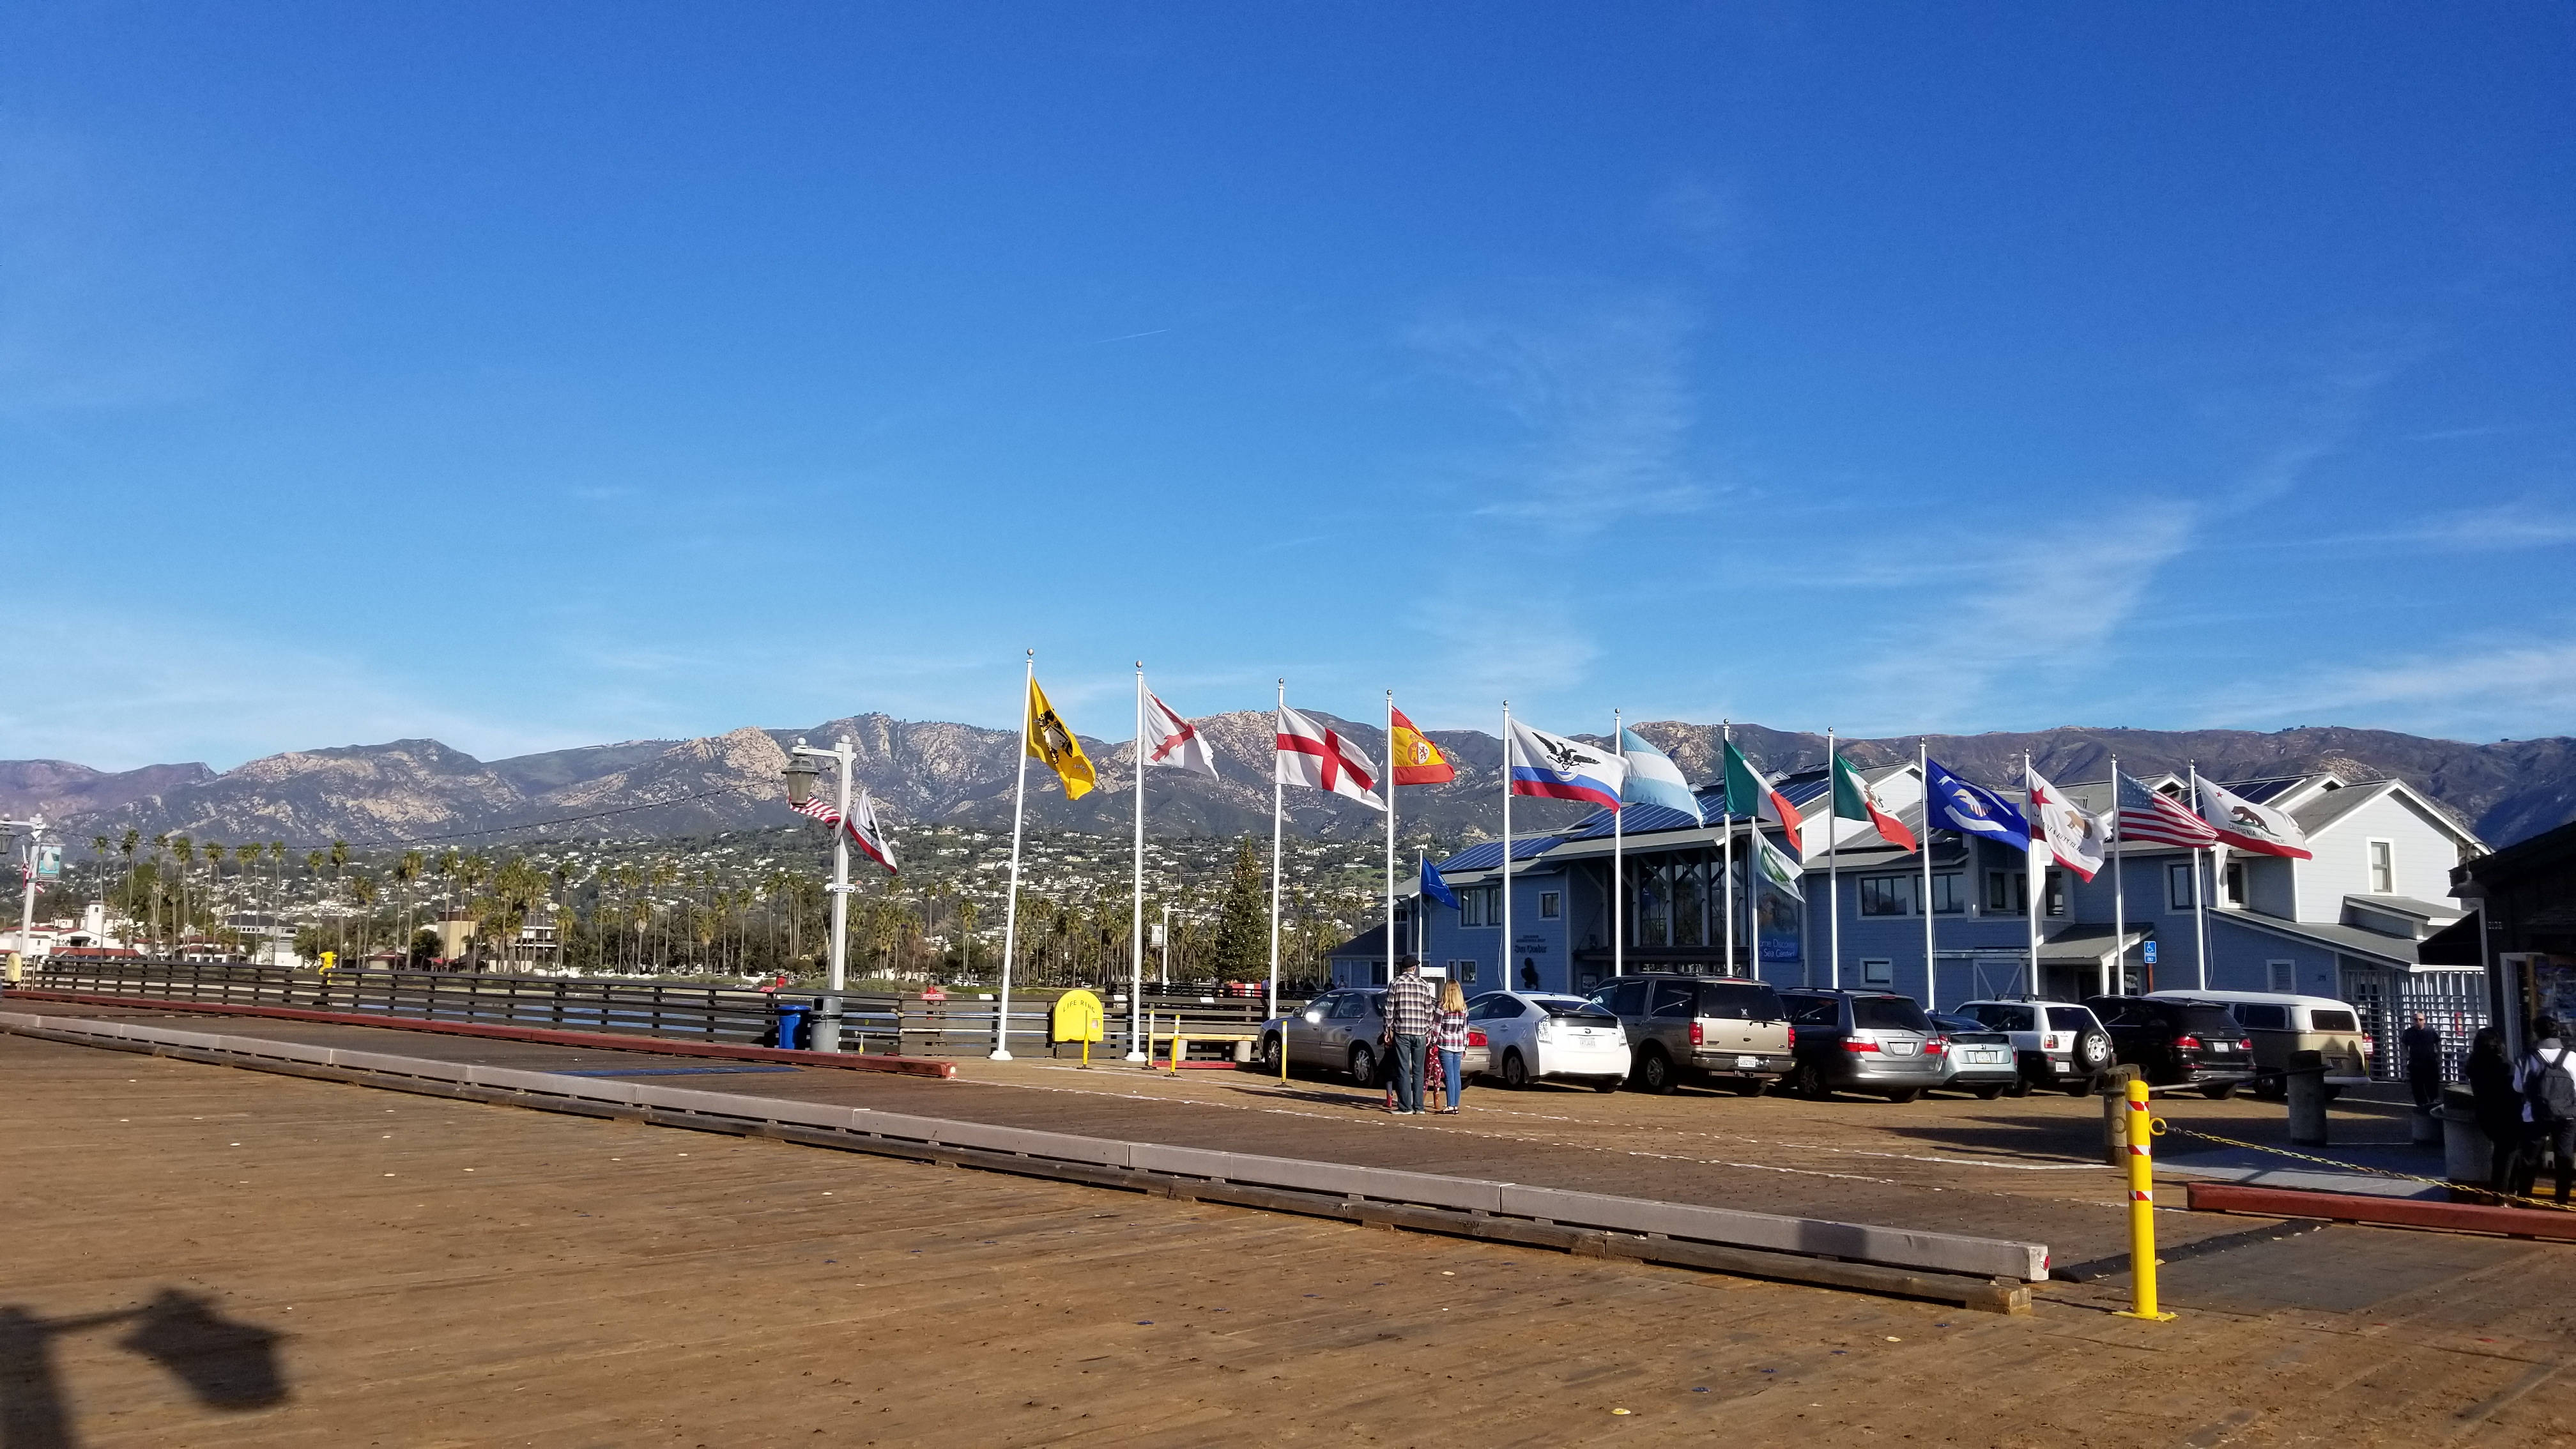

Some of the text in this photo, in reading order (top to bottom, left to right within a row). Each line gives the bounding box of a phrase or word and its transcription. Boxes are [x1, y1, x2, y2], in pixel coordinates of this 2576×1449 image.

[1763, 948, 1774, 957] Sea
[1063, 1000, 1095, 1013] LIFE RING
